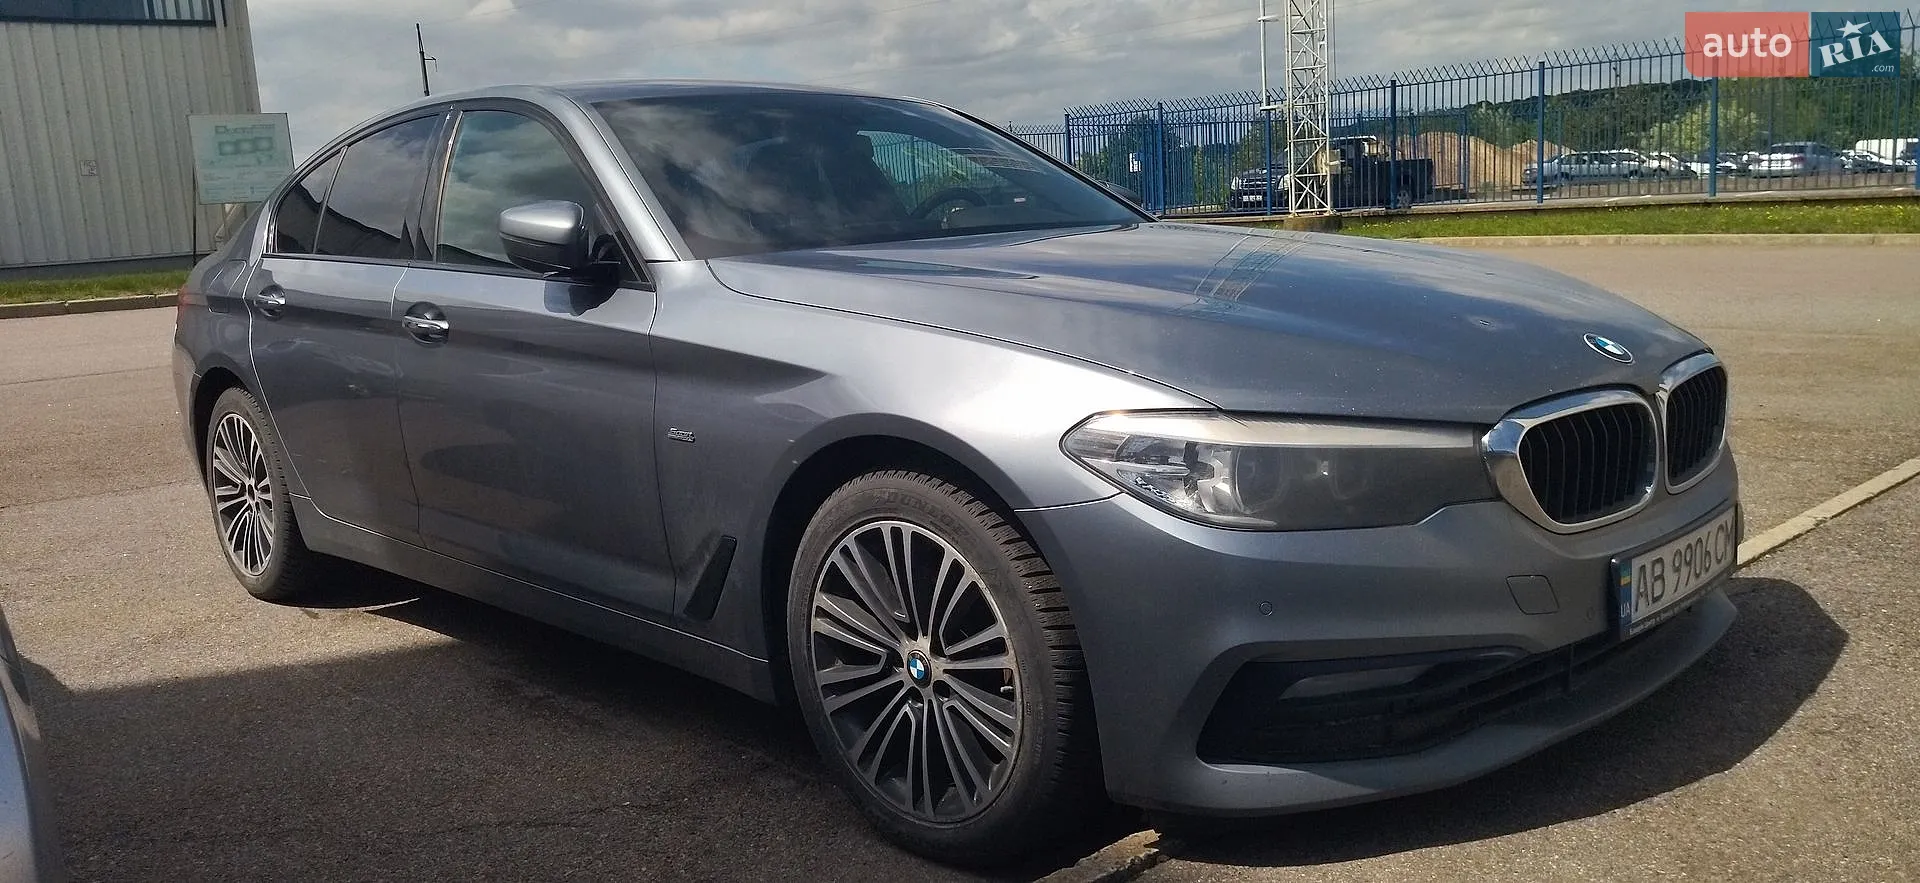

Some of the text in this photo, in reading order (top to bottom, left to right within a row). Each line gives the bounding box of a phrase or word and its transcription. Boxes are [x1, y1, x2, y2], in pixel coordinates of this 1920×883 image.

[1635, 556, 1666, 613] AB
[1672, 531, 1712, 594] 9906
[1620, 602, 1631, 618] UA
